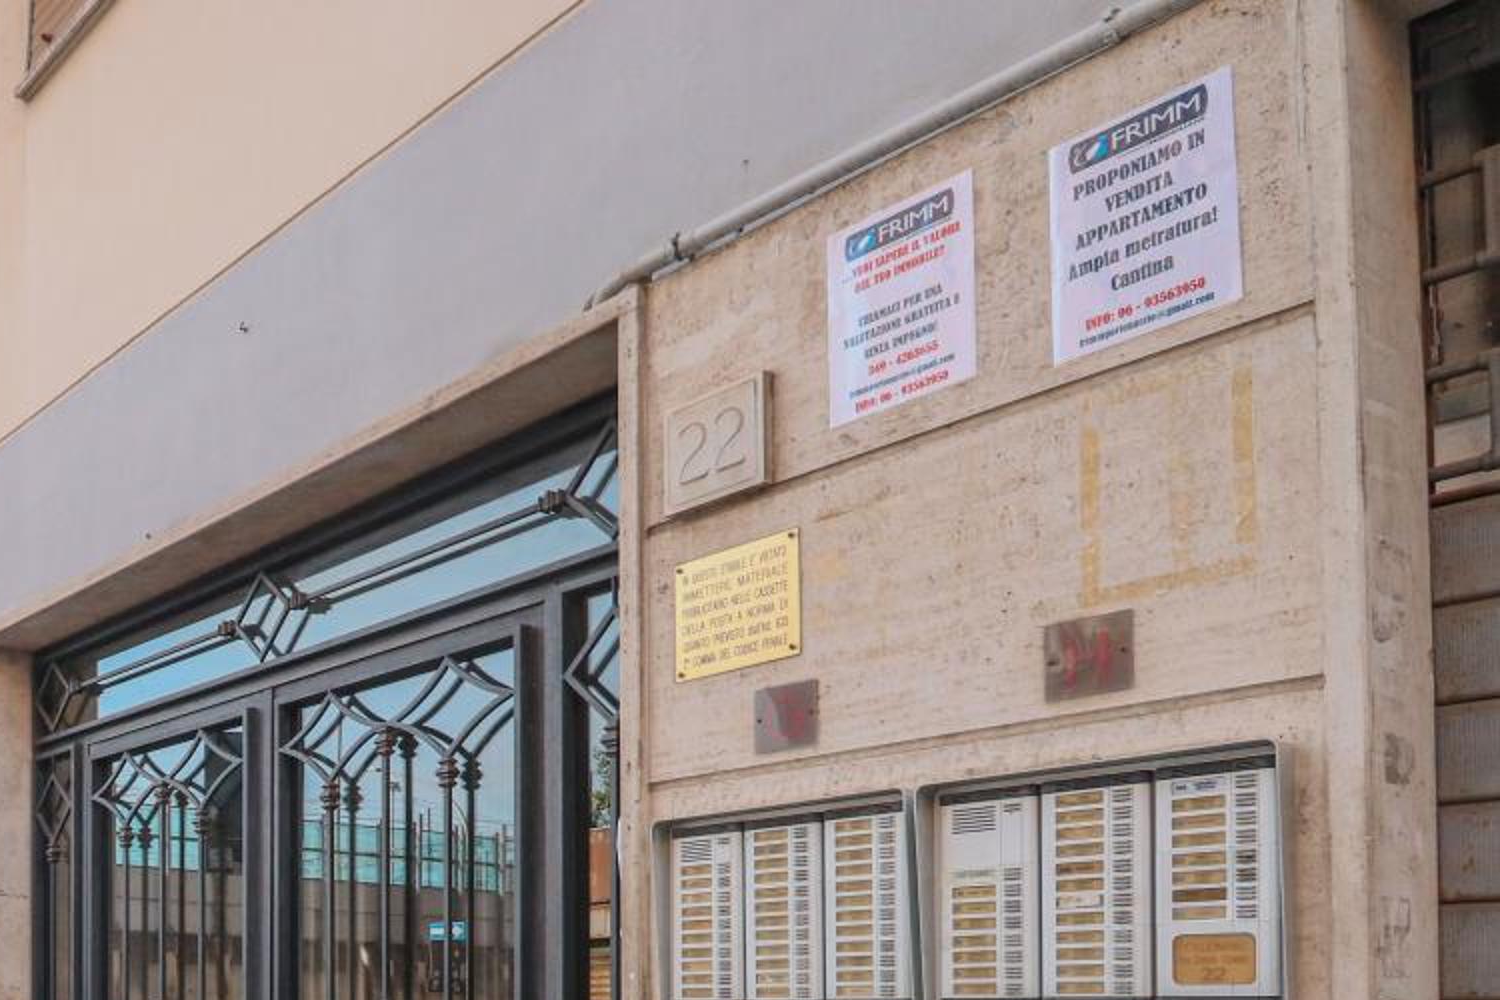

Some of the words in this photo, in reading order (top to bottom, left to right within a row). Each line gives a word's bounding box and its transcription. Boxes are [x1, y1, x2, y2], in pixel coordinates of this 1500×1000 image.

[1111, 91, 1201, 152] FRIMM
[1072, 139, 1182, 200] PROPONIAMO
[1187, 128, 1205, 150] IN
[1104, 170, 1174, 213] VENDITA
[877, 195, 950, 244] FRIMM
[1068, 247, 1119, 282] Ampia
[1125, 205, 1218, 258] metratura!
[1075, 183, 1208, 250] APPARTAMENTO
[1111, 255, 1174, 291] Cantina
[678, 406, 746, 486] 22
